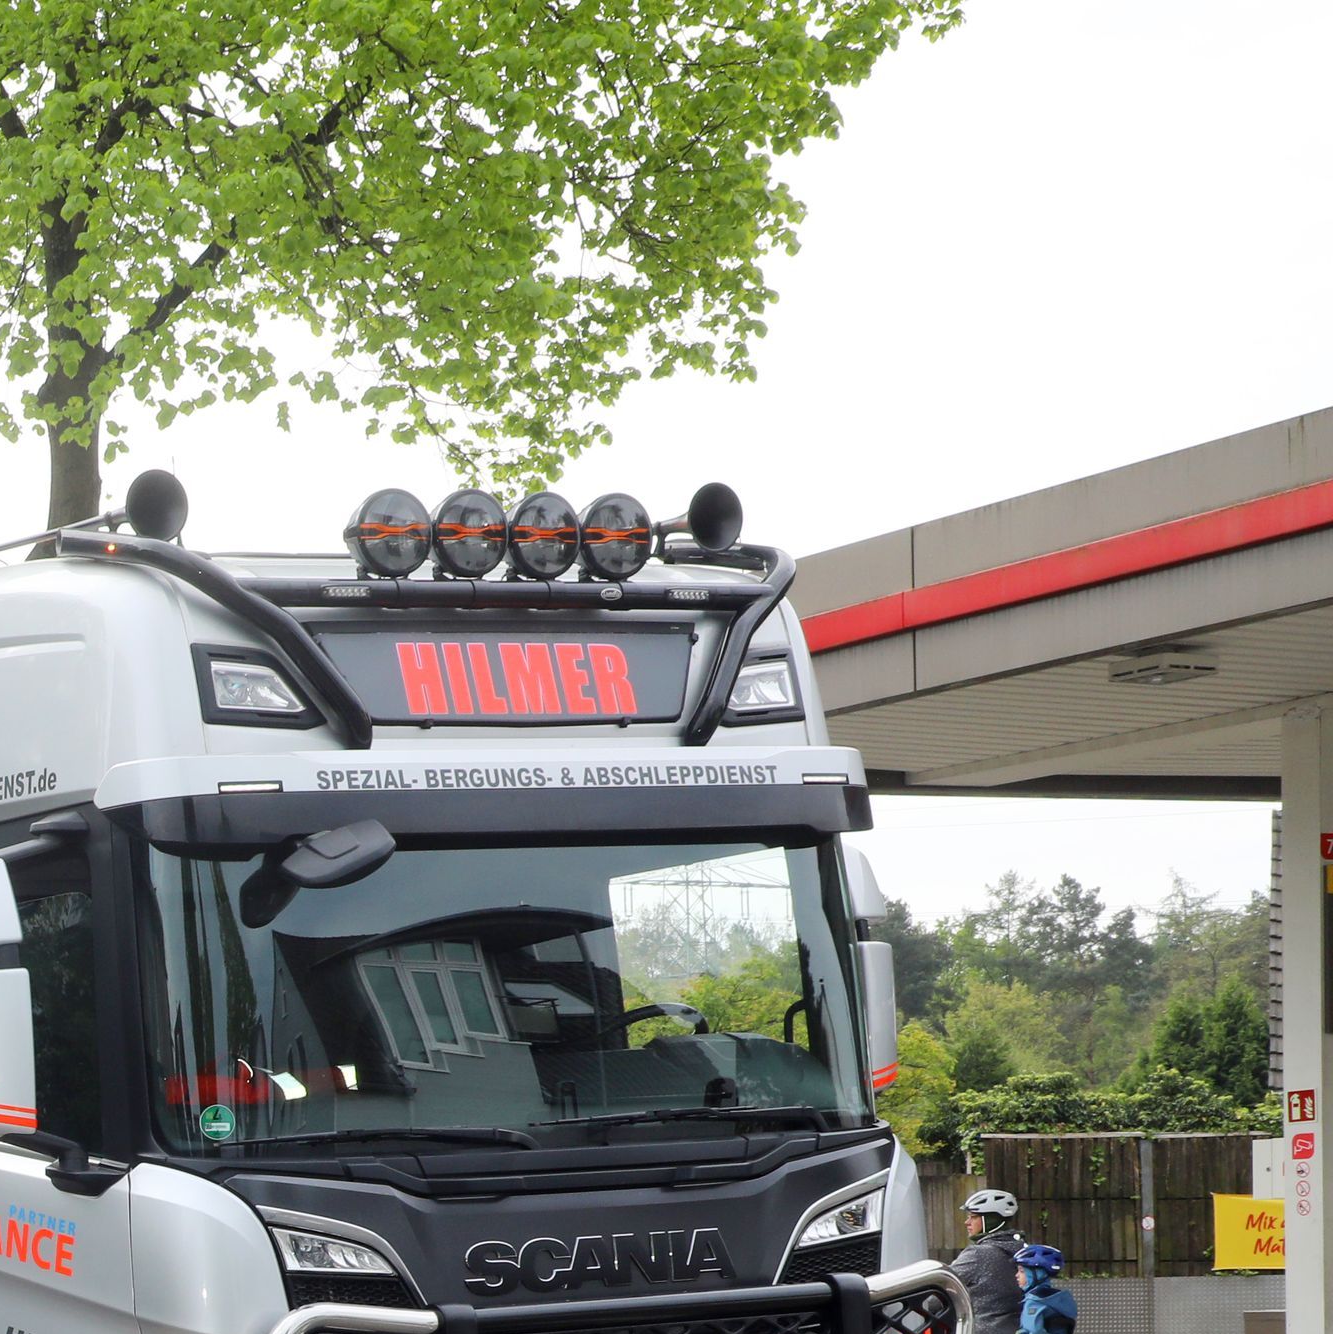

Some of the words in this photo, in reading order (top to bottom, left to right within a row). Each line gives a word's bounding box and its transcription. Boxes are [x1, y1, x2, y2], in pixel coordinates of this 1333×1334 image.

[395, 642, 638, 714] HILMER
[316, 769, 419, 790] SPEZIAL-
[425, 767, 553, 789] BERGUNGS-
[560, 767, 576, 786] &
[582, 765, 778, 786] ABSCHLEPPDIENST
[9, 1204, 76, 1236] PARTNER
[1245, 1211, 1278, 1232] Mix
[1253, 1236, 1285, 1257] Mat
[464, 1227, 736, 1298] SCANIA
